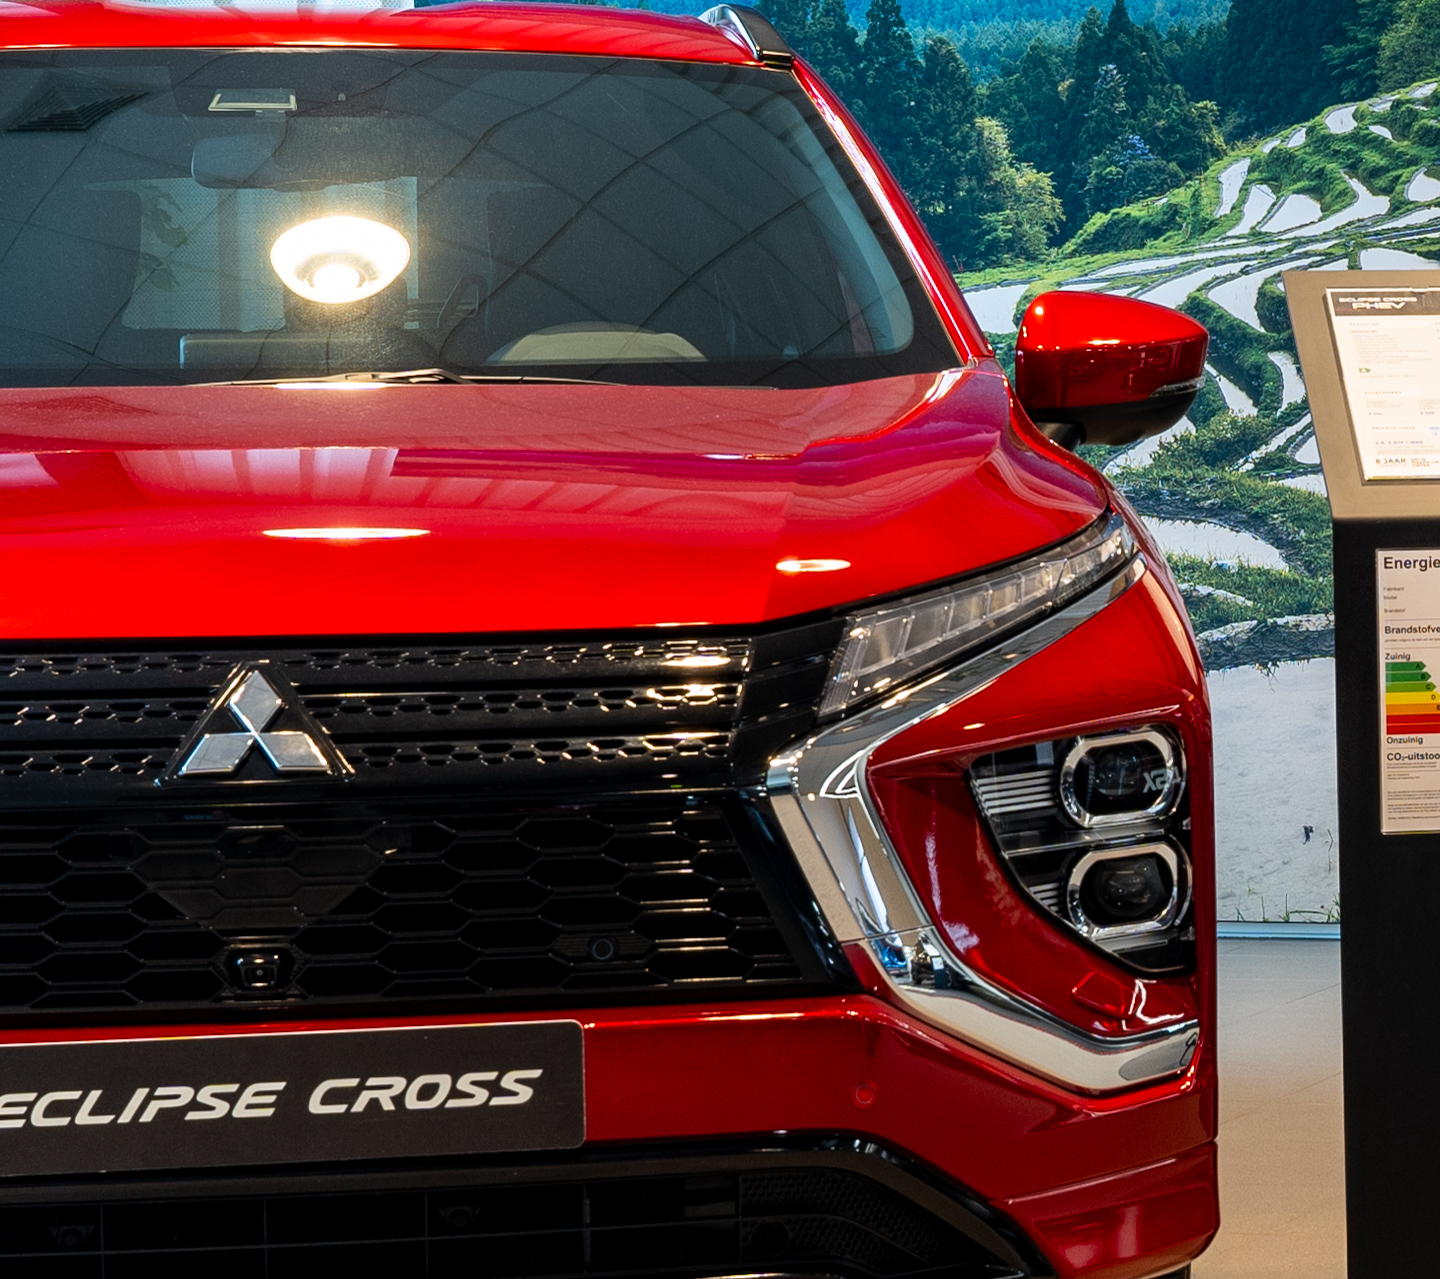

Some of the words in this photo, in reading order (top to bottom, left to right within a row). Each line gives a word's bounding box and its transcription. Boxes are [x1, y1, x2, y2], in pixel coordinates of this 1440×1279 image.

[1385, 652, 1411, 662] Zuinig
[1386, 736, 1423, 745] Onzuinig
[307, 1068, 543, 1115] CROSS
